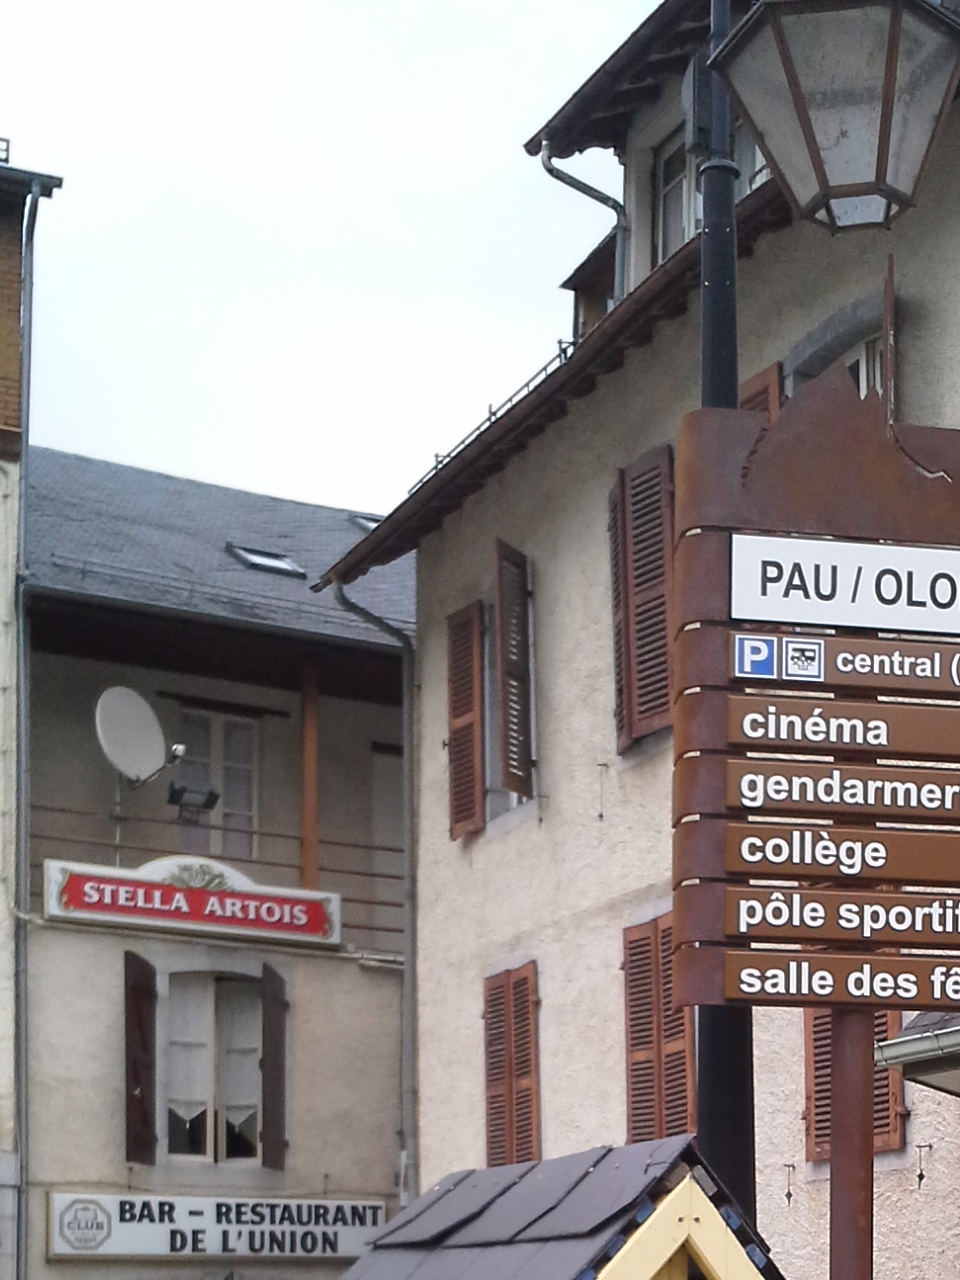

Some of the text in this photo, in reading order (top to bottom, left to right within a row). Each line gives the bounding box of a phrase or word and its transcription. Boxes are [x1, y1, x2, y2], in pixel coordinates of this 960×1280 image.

[759, 559, 838, 603] PAU
[743, 639, 769, 673] P
[836, 649, 942, 680] central
[742, 705, 890, 746] cinéma
[740, 833, 888, 875] collège
[82, 881, 309, 926] STELLA ARTOIS
[738, 894, 827, 934] pôle
[739, 962, 835, 995] salle
[846, 964, 918, 999] des
[67, 1219, 105, 1231] CLUB
[118, 1200, 176, 1224] BAR
[215, 1202, 383, 1227] RESTAURANT
[169, 1228, 339, 1254] DE L'UNION
